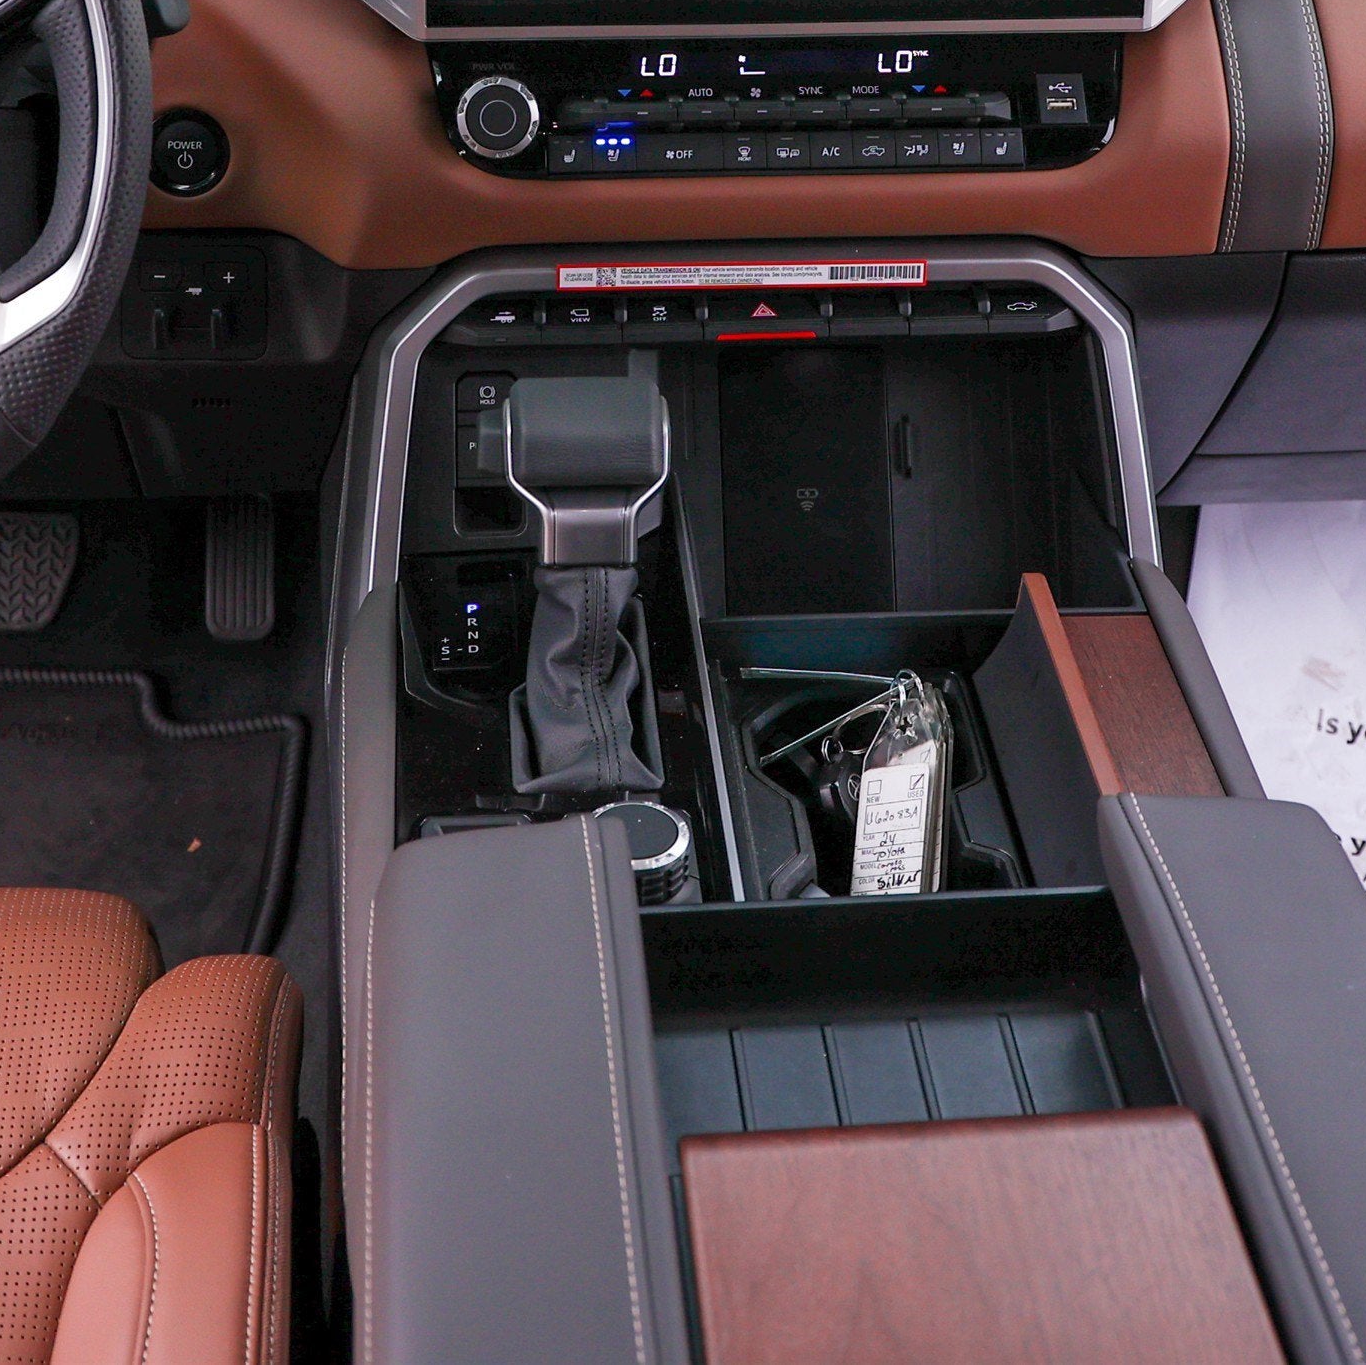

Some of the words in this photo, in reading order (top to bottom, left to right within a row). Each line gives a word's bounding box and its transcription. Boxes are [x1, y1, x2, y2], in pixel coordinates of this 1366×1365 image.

[640, 53, 677, 77] LO
[877, 50, 913, 73] LO
[688, 87, 713, 98] AUTO
[798, 86, 823, 95] SYNC
[852, 85, 880, 94] MODE
[168, 140, 203, 151] POWER
[675, 149, 693, 159] OFF
[822, 146, 840, 157] A/C
[467, 603, 477, 614] P
[468, 618, 478, 626] R
[468, 631, 479, 639] N
[441, 645, 450, 655] S
[468, 645, 479, 653] D
[1316, 708, 1338, 735] Is
[907, 789, 925, 798] USED
[866, 796, 880, 804] NEW
[860, 862, 876, 870] MODEL
[858, 877, 875, 885] COLOR
